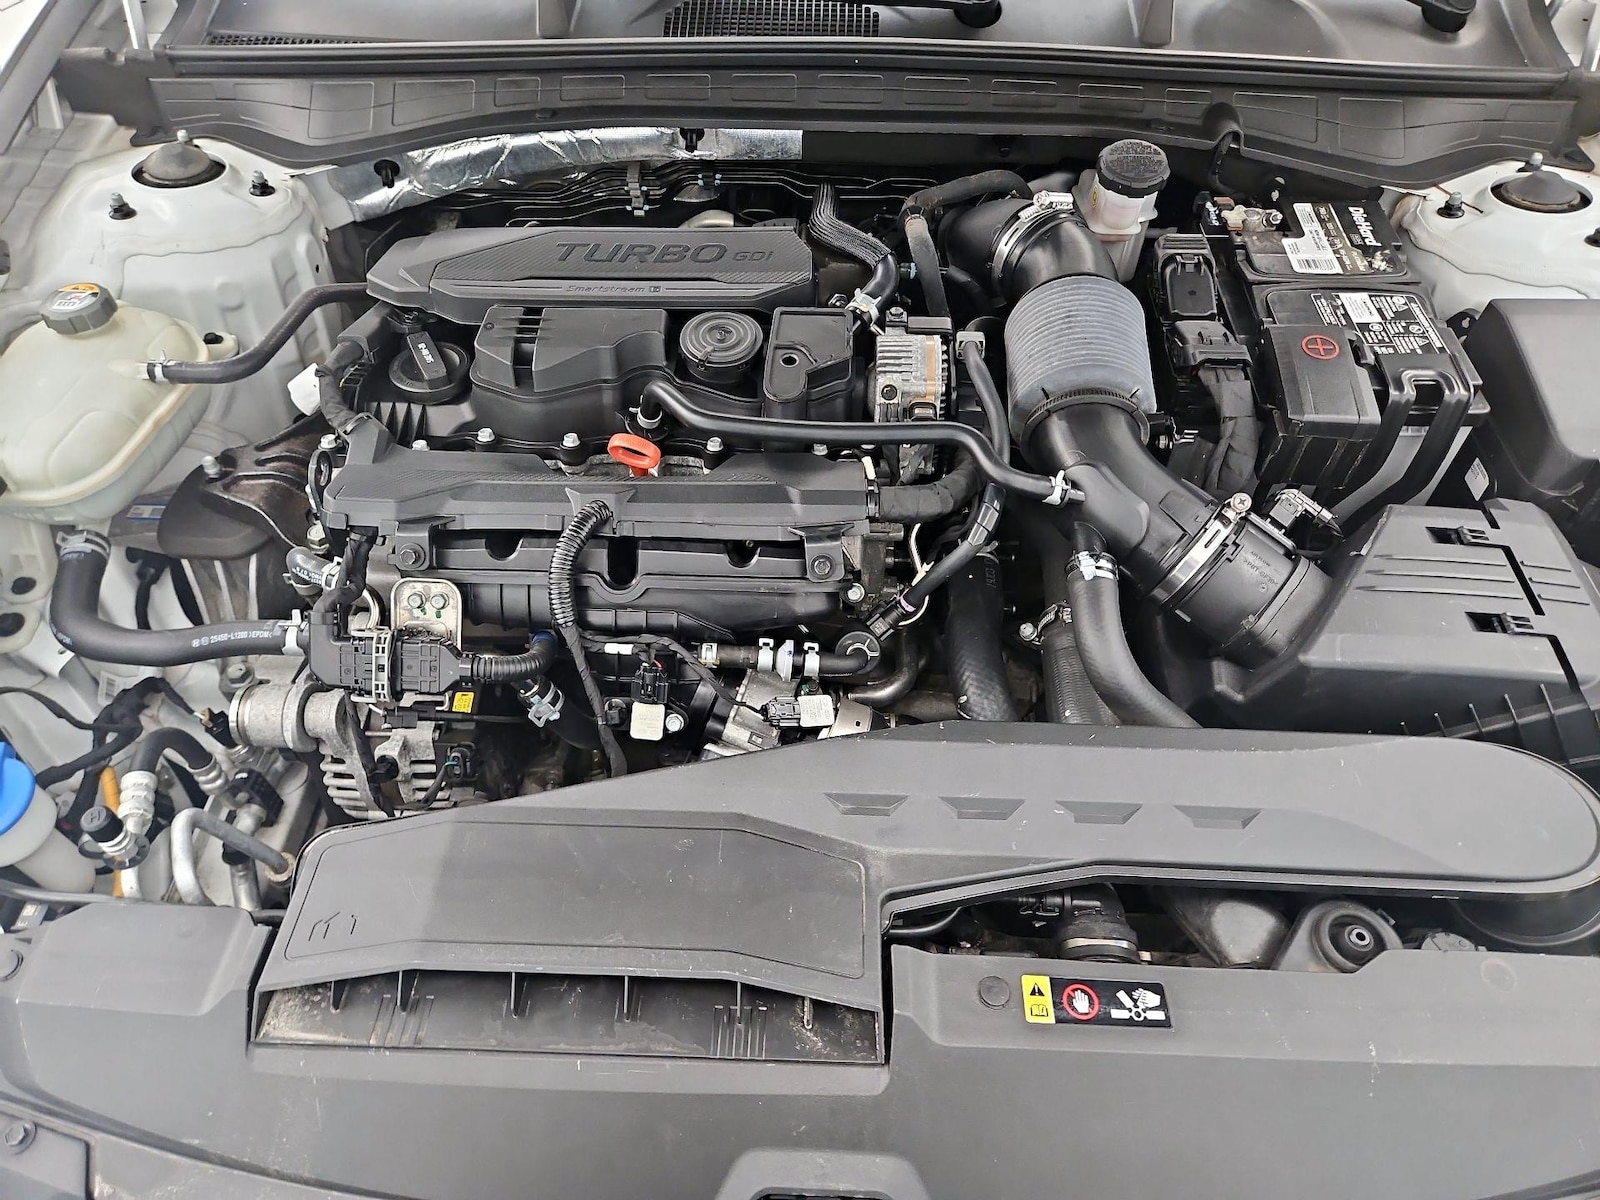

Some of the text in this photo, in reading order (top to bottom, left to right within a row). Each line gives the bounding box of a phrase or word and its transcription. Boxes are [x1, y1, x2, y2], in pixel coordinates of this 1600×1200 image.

[1348, 206, 1382, 247] DieHard
[556, 242, 728, 264] TURBO
[566, 285, 645, 293] Smartstream
